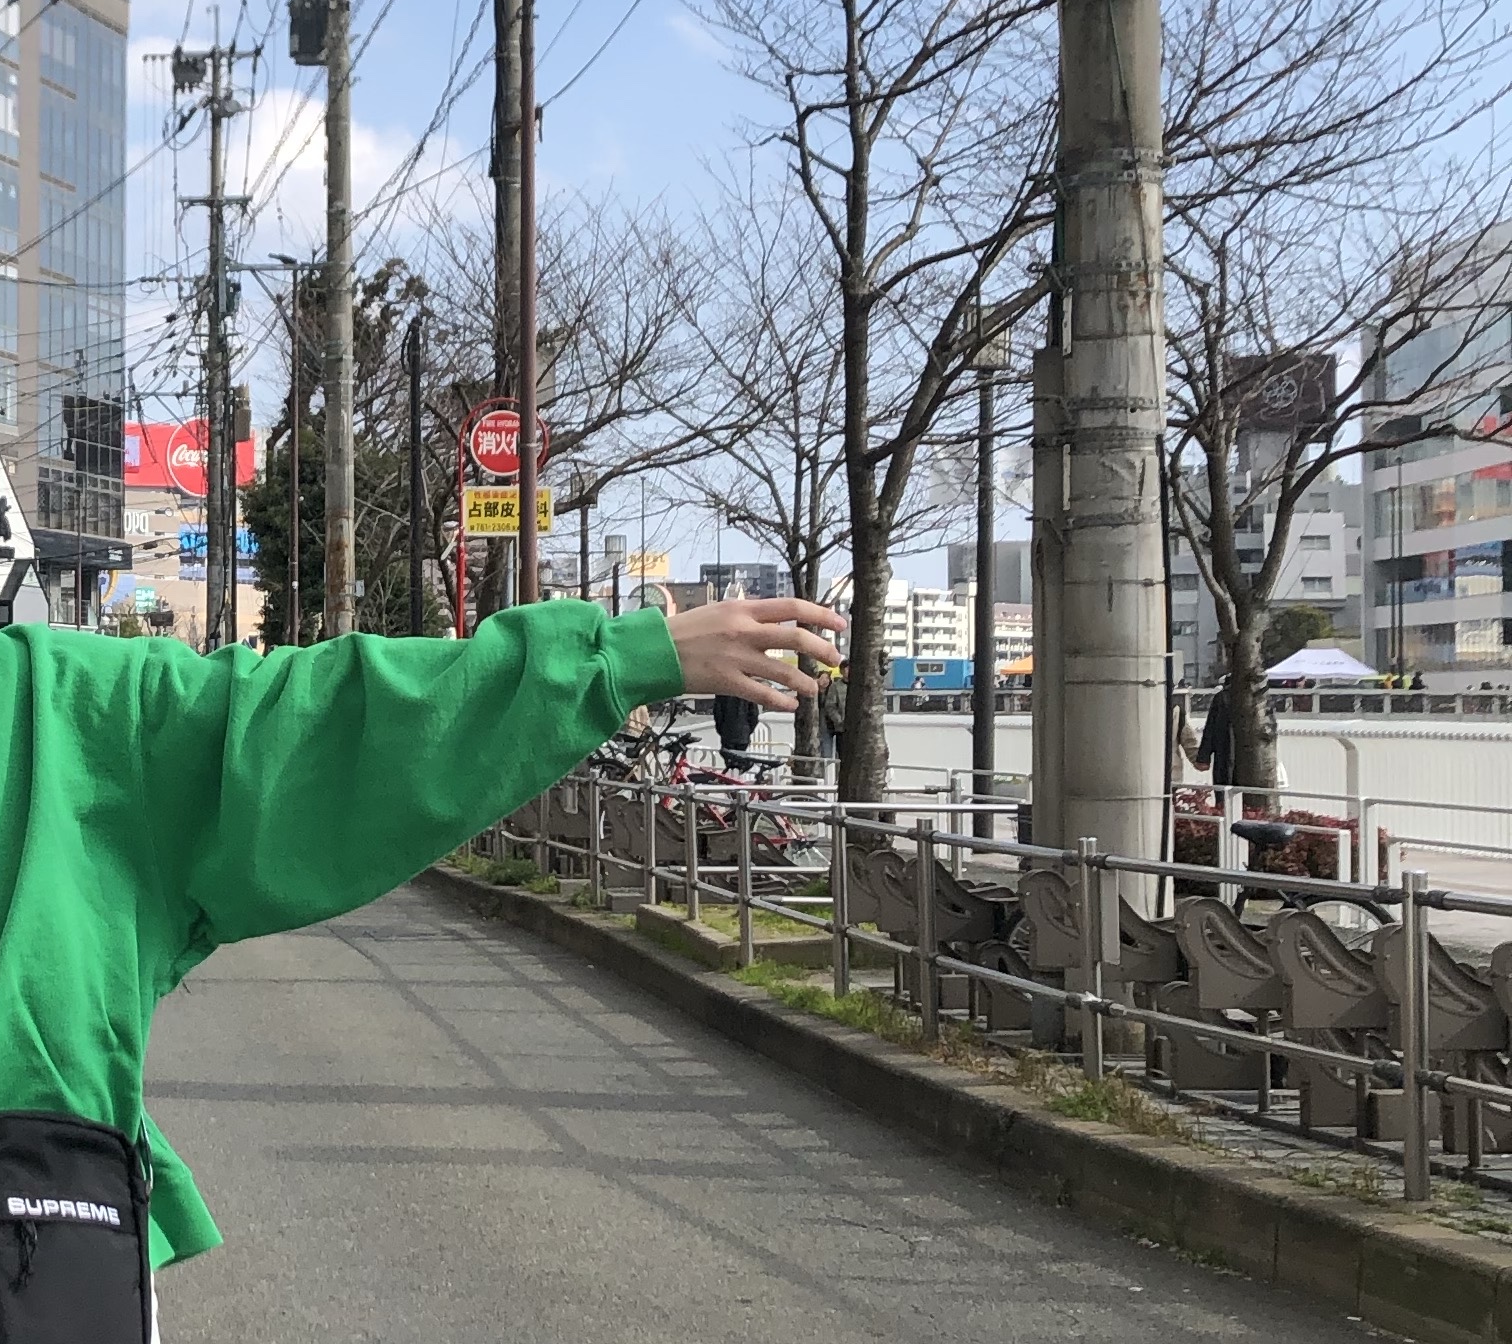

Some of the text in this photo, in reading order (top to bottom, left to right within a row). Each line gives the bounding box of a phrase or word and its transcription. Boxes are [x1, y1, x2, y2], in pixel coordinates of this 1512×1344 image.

[468, 500, 549, 518] 占部皮科
[6, 1196, 121, 1226] SUPREME
